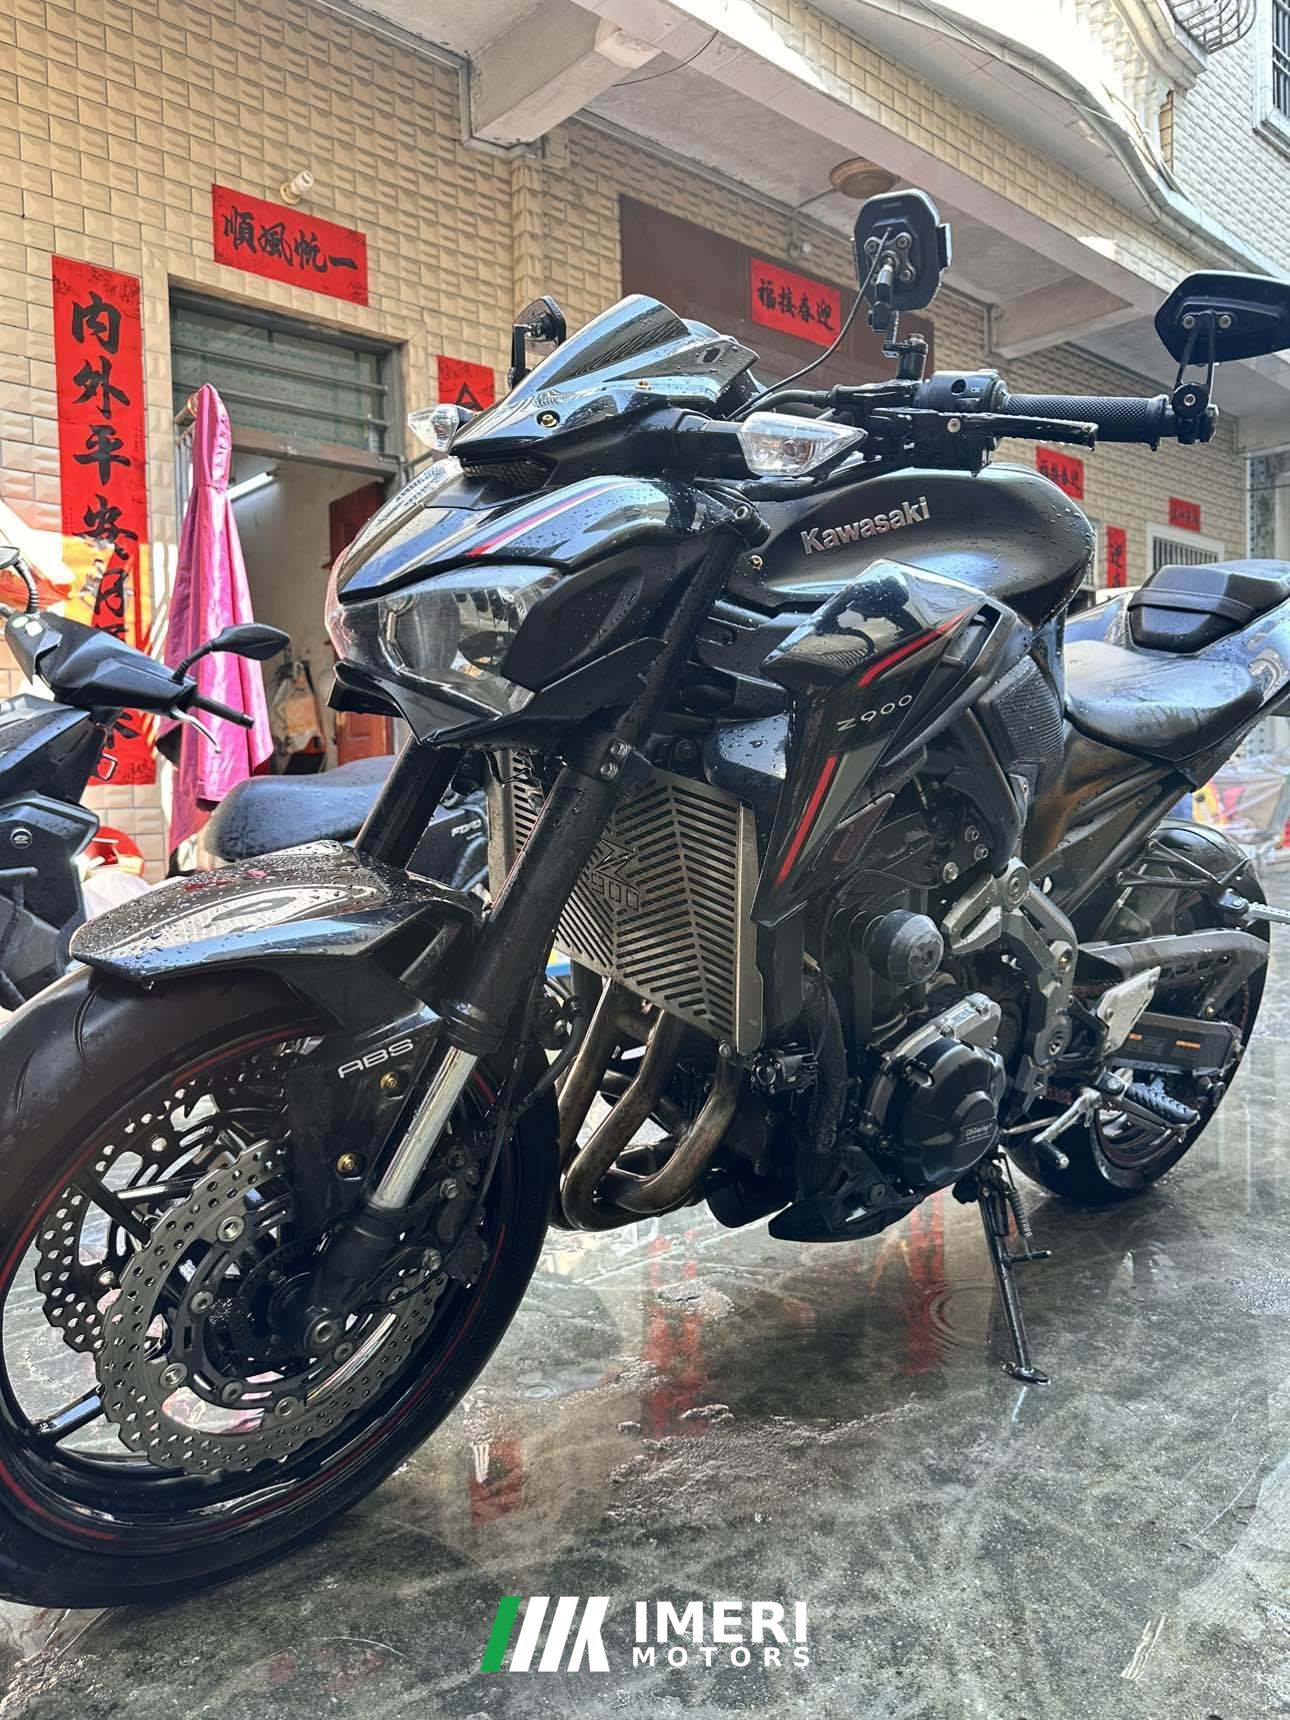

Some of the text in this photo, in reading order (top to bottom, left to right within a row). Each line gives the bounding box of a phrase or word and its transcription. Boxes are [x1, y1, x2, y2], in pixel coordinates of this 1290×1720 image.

[800, 496, 930, 554] Kawasaki
[837, 695, 912, 731] Z900
[337, 1038, 414, 1079] ABS
